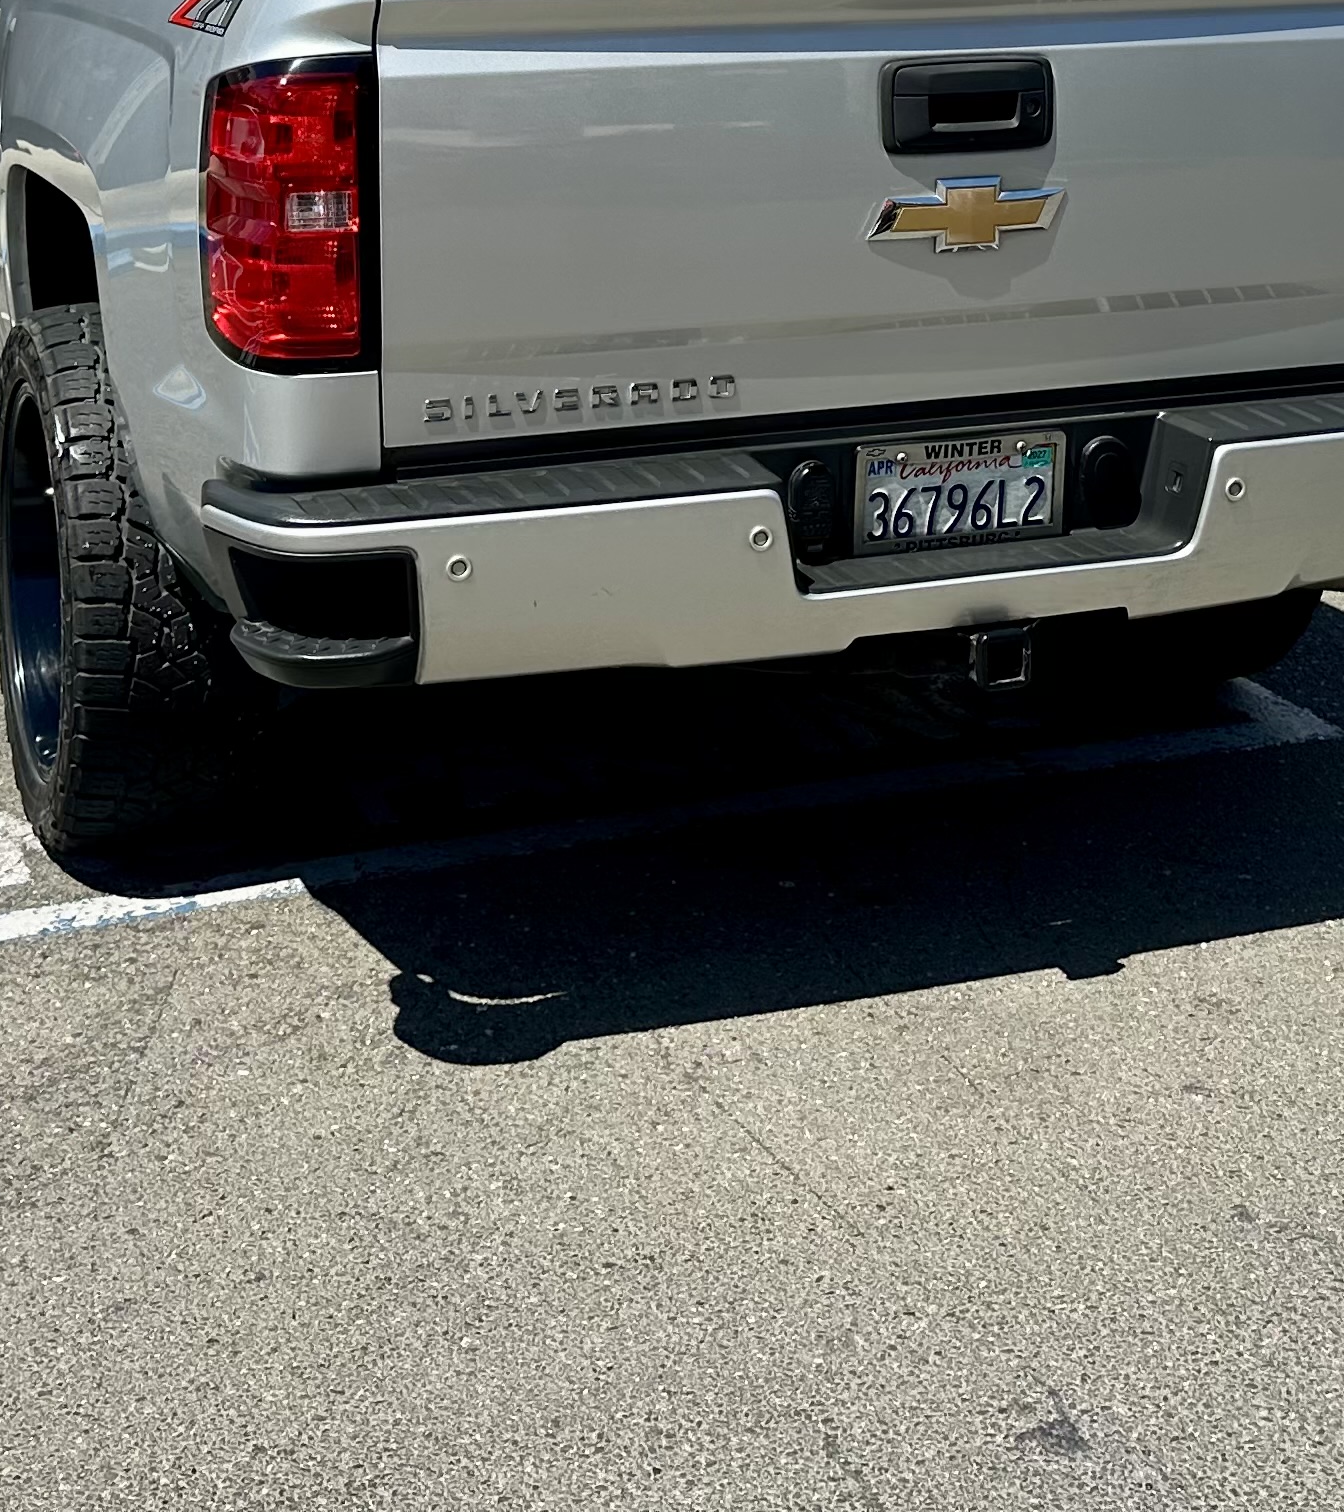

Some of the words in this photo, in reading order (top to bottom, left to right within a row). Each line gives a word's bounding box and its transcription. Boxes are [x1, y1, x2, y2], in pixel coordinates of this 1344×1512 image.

[423, 375, 735, 422] SILVERADO
[924, 439, 1002, 460] WINTER
[867, 461, 894, 477] APR
[899, 455, 1023, 484] California
[866, 475, 1046, 541] 36796L2
